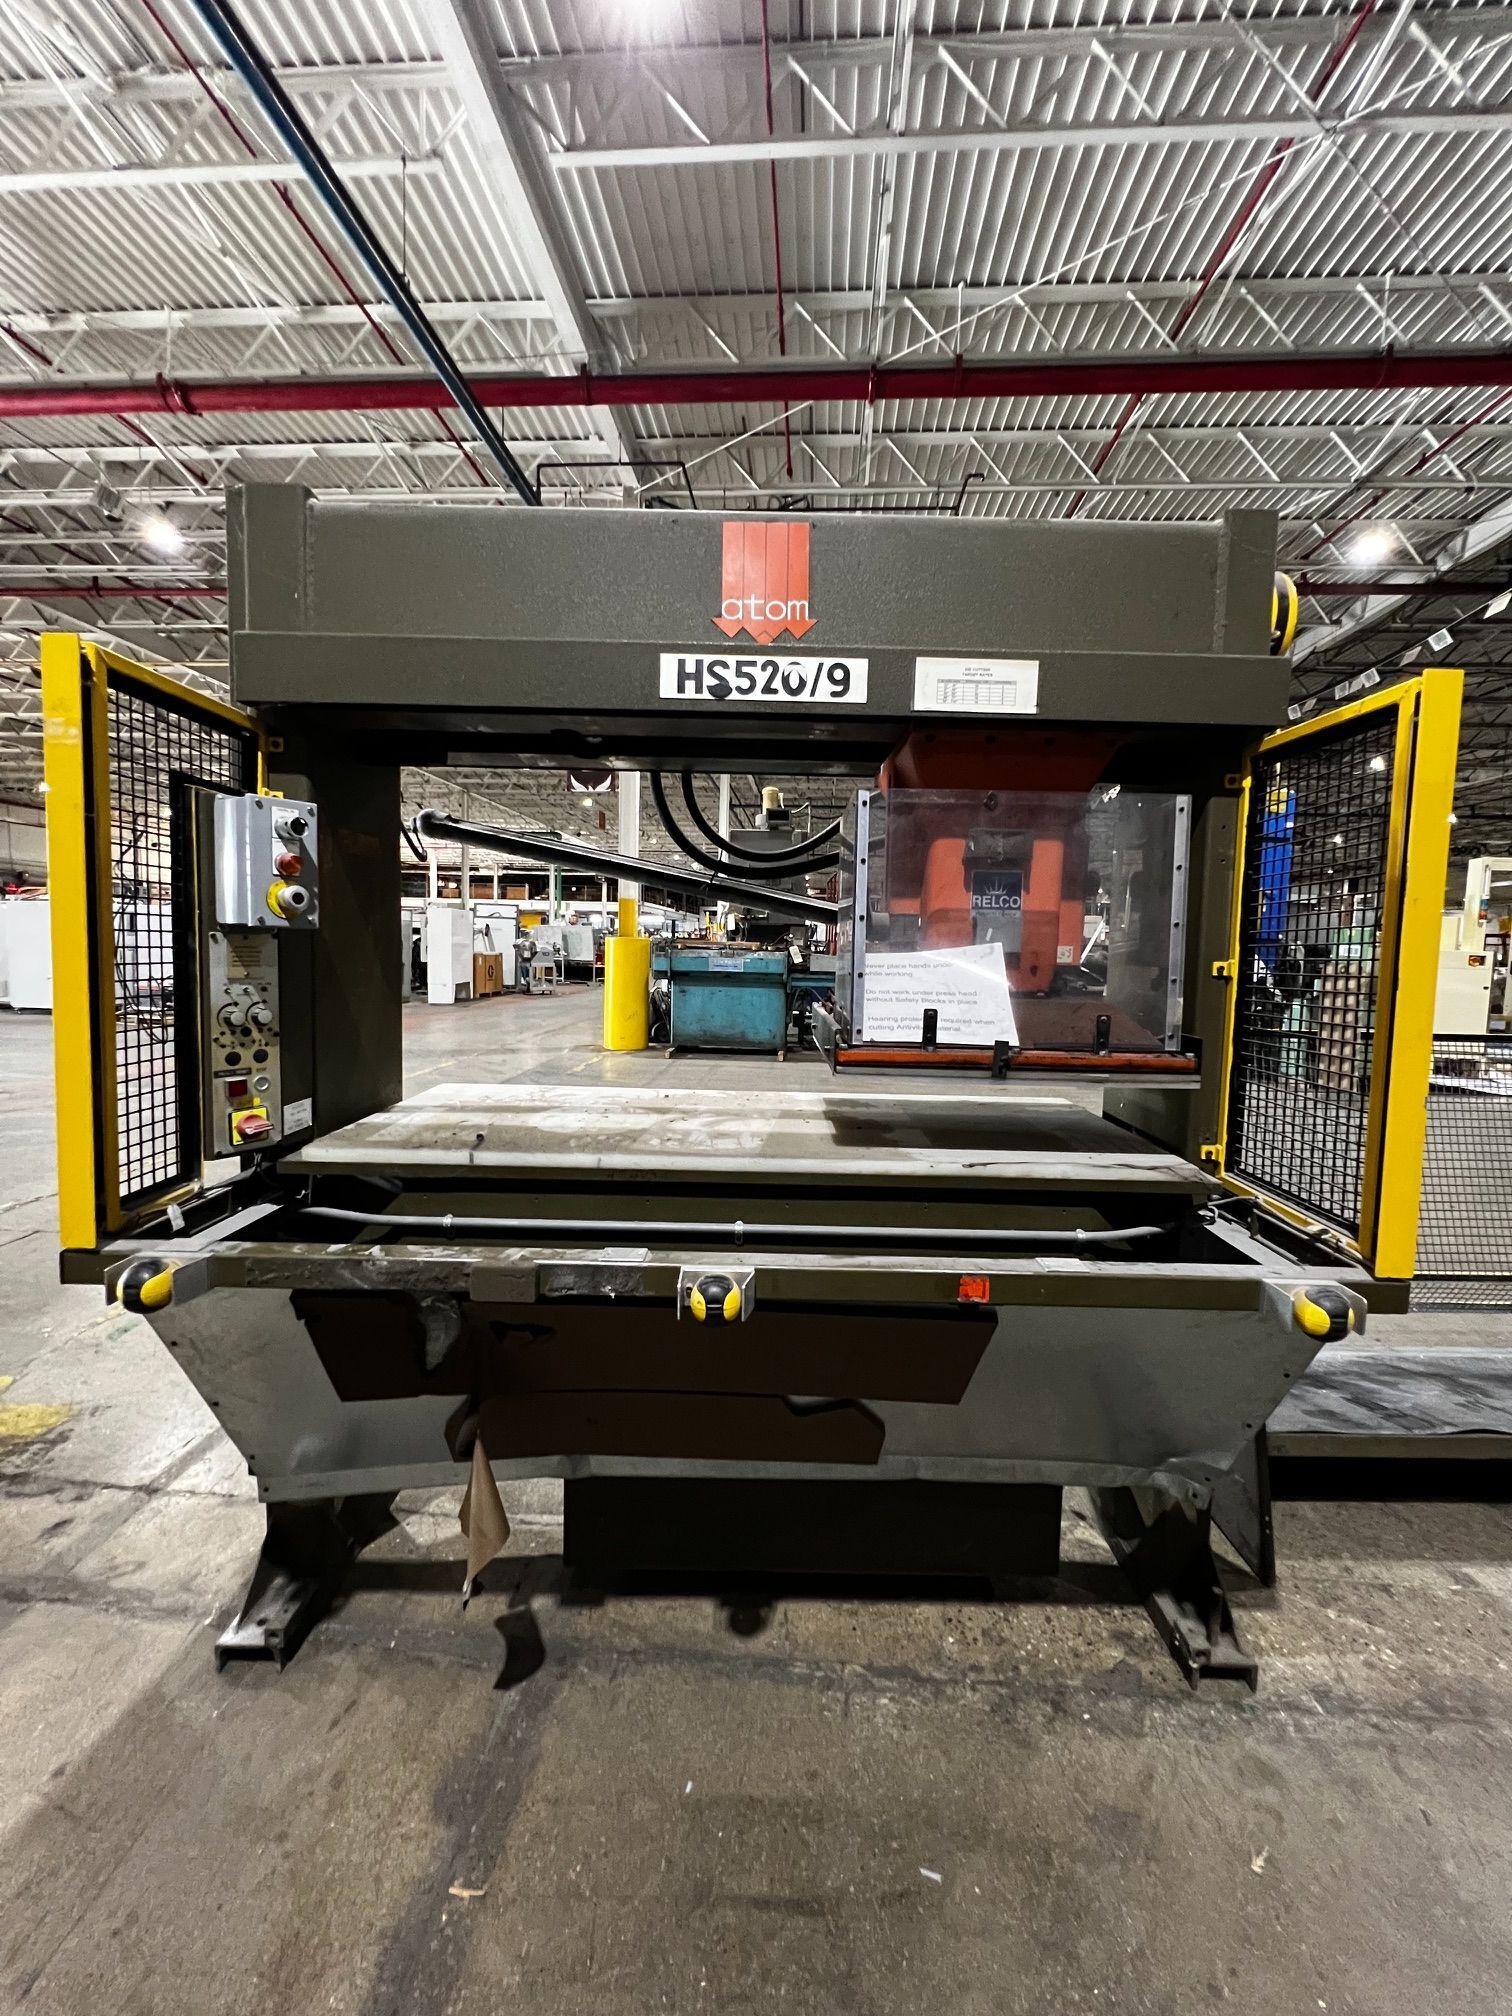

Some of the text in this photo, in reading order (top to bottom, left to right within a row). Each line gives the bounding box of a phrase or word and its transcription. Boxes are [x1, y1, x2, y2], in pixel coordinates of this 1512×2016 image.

[721, 594, 809, 621] atom
[677, 658, 851, 699] HS520/9
[972, 895, 1021, 908] RELCO
[867, 1015, 899, 1023] Hearing
[940, 1017, 972, 1025] required
[868, 1024, 895, 1032] cutting
